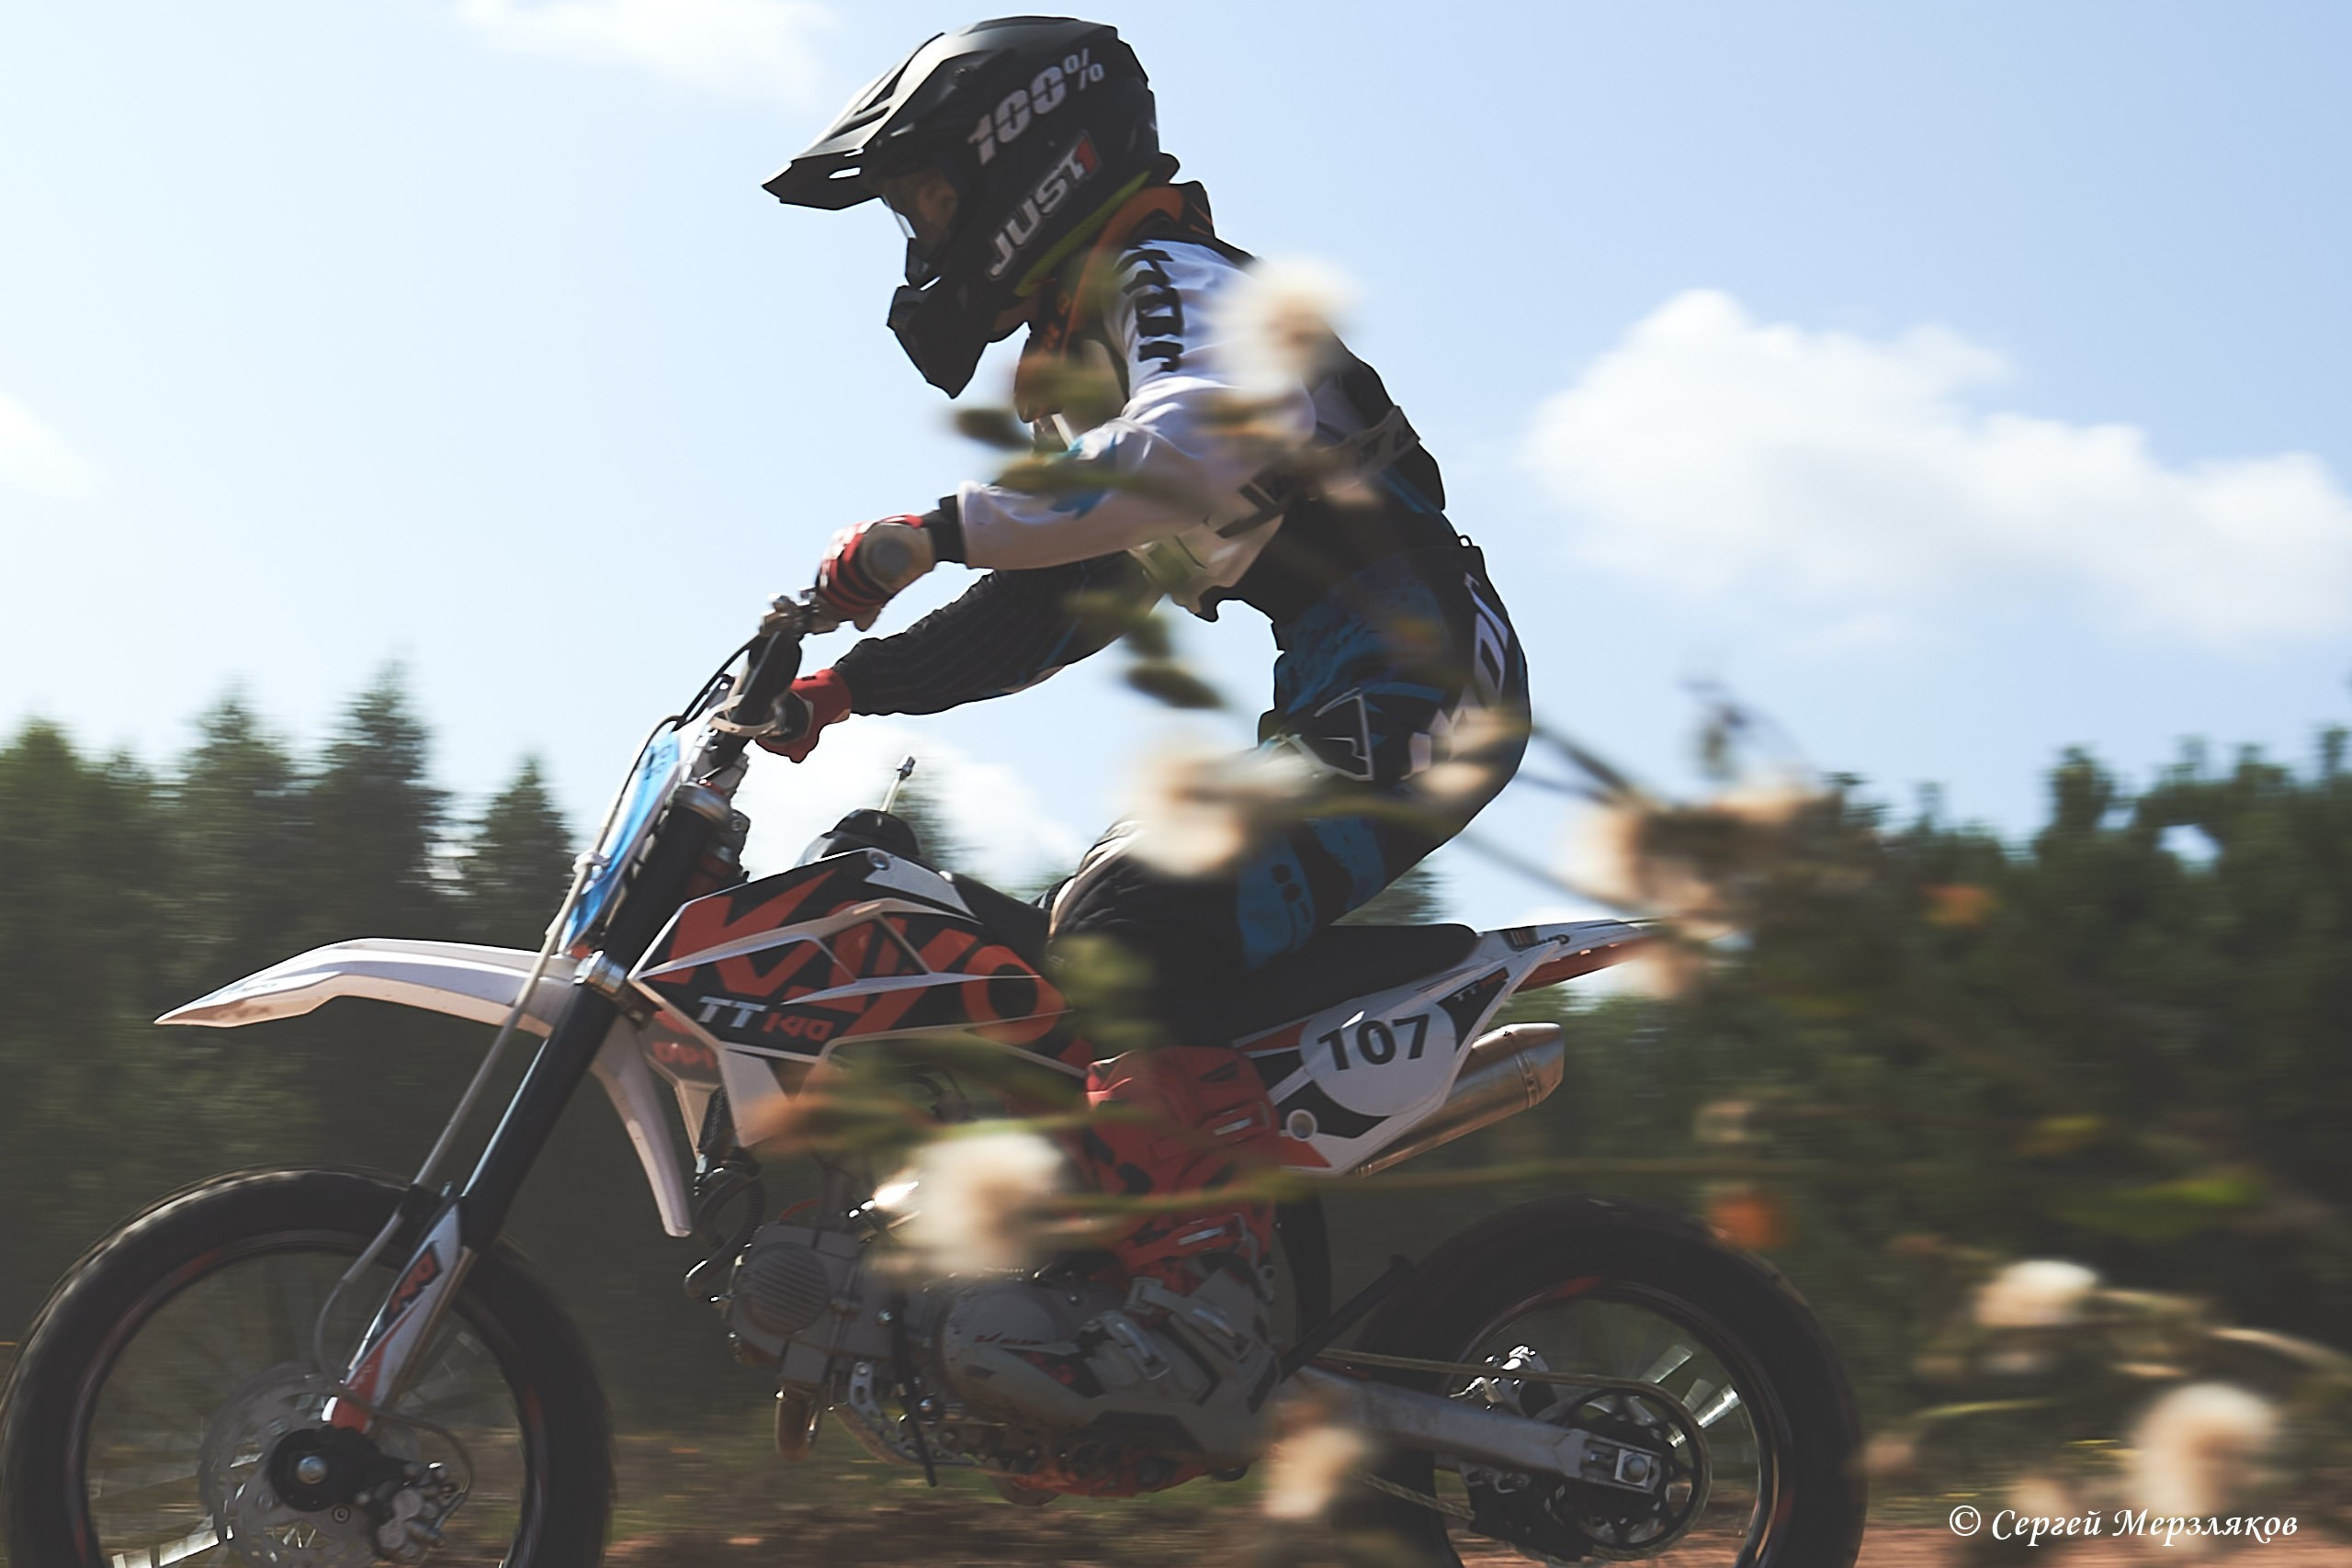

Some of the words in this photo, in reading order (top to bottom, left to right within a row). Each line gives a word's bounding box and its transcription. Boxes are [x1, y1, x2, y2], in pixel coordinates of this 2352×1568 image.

[967, 48, 1104, 165] 100%
[696, 996, 768, 1029] TT
[762, 1011, 834, 1043] 140
[1317, 1013, 1430, 1071] 107
